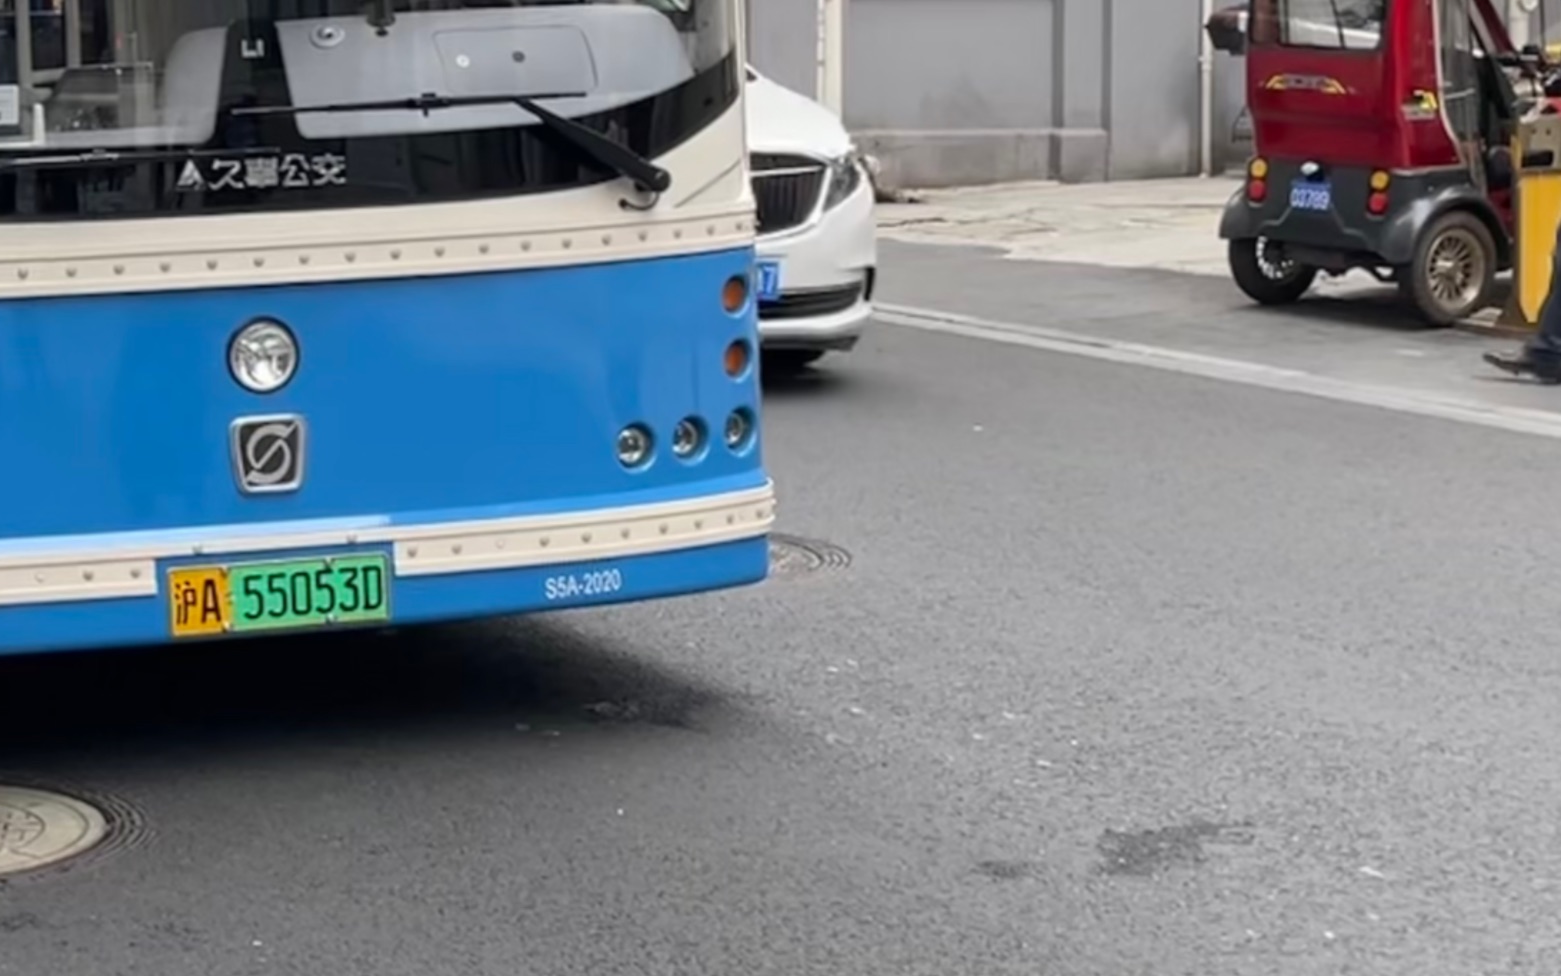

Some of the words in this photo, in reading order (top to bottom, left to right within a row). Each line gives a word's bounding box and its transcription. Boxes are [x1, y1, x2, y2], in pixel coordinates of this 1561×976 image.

[174, 578, 222, 626] 沪A
[242, 565, 384, 620] 55053D
[544, 567, 623, 600] S5A-2020
